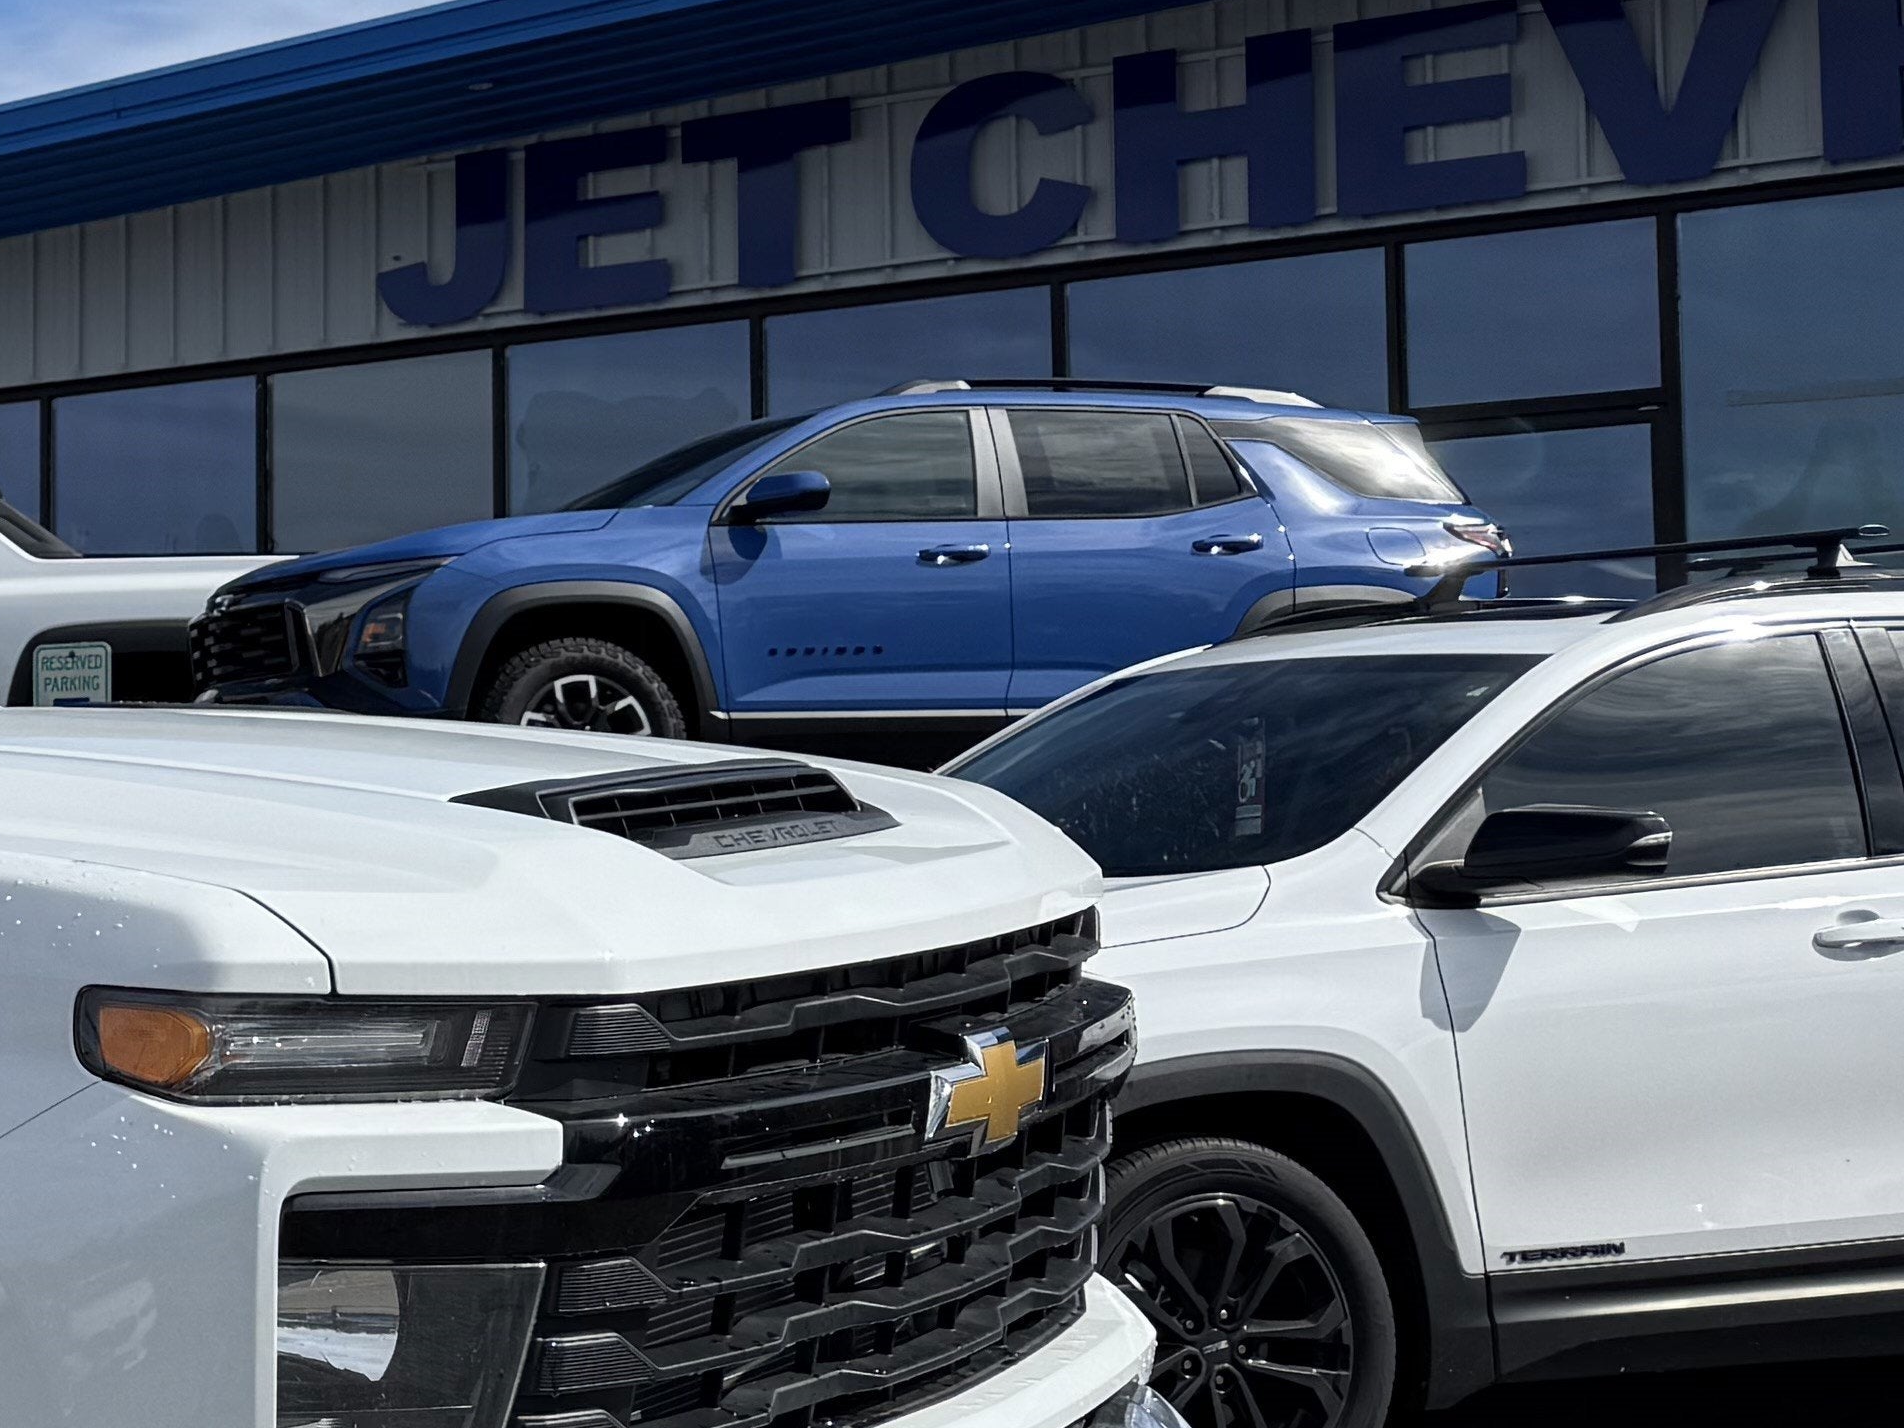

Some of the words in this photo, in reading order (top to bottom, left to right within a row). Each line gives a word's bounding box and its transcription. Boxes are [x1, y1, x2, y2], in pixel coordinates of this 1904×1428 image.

[376, 97, 851, 327] JET
[42, 655, 103, 672] RESERVED
[44, 675, 100, 692] PARKING
[712, 820, 839, 849] CHEVROLET
[1500, 1241, 1626, 1266] TERRAIN
